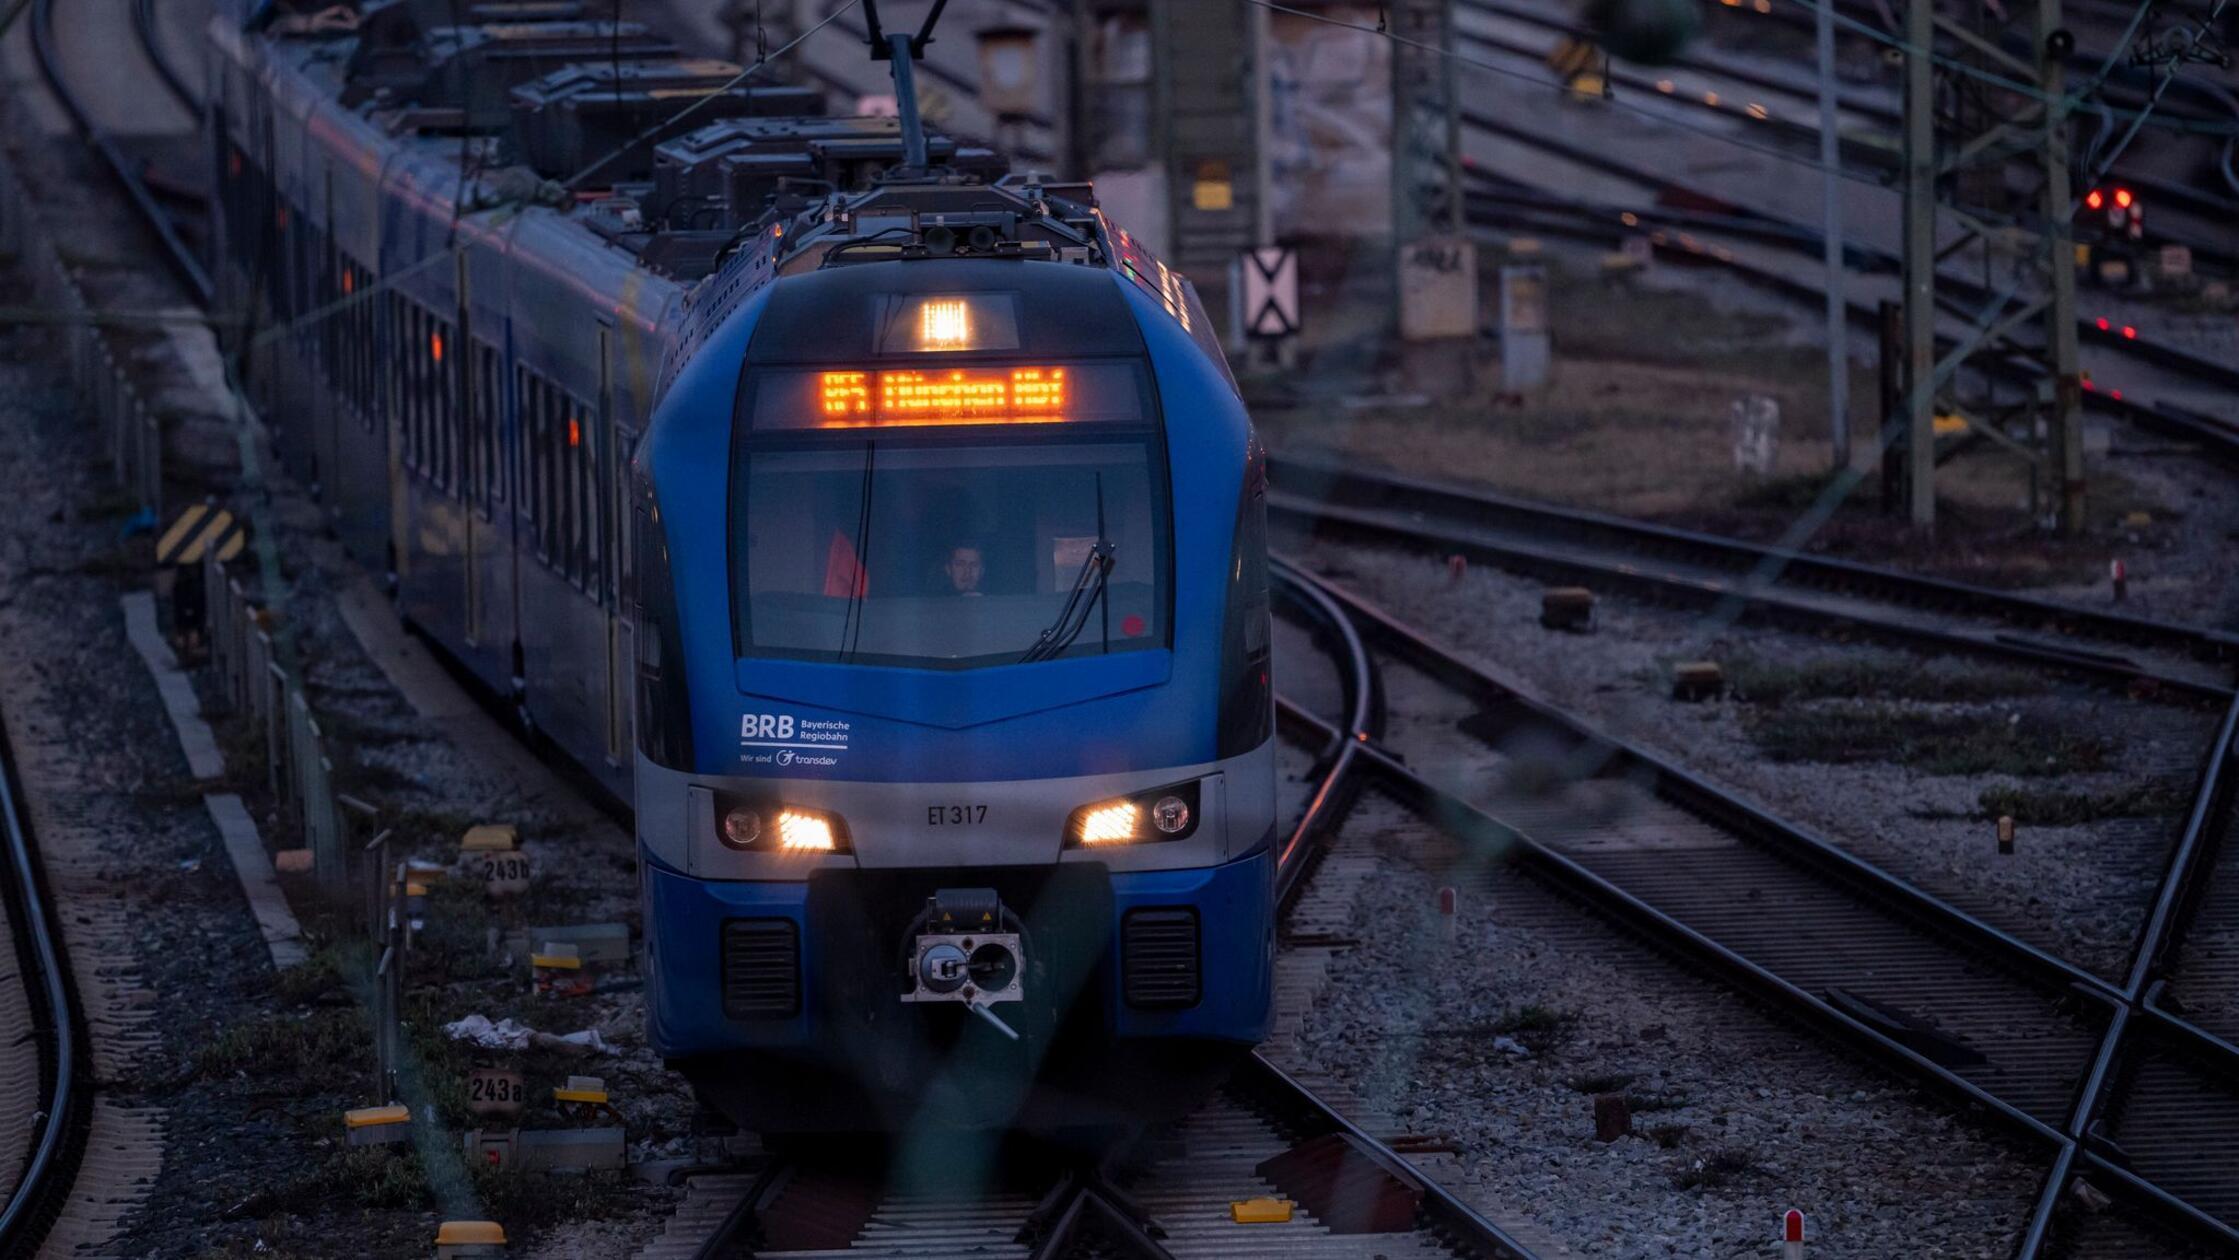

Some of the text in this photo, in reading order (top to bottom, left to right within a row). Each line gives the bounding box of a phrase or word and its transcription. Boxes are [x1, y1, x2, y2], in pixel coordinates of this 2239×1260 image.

[885, 375, 1005, 407] München
[1014, 370, 1062, 405] Hbf
[741, 713, 795, 739] BRB
[800, 719, 850, 731] Bayerische
[800, 731, 849, 742] Regiobahn
[740, 754, 838, 766] Wir sind transdev
[928, 805, 988, 825] ET 317
